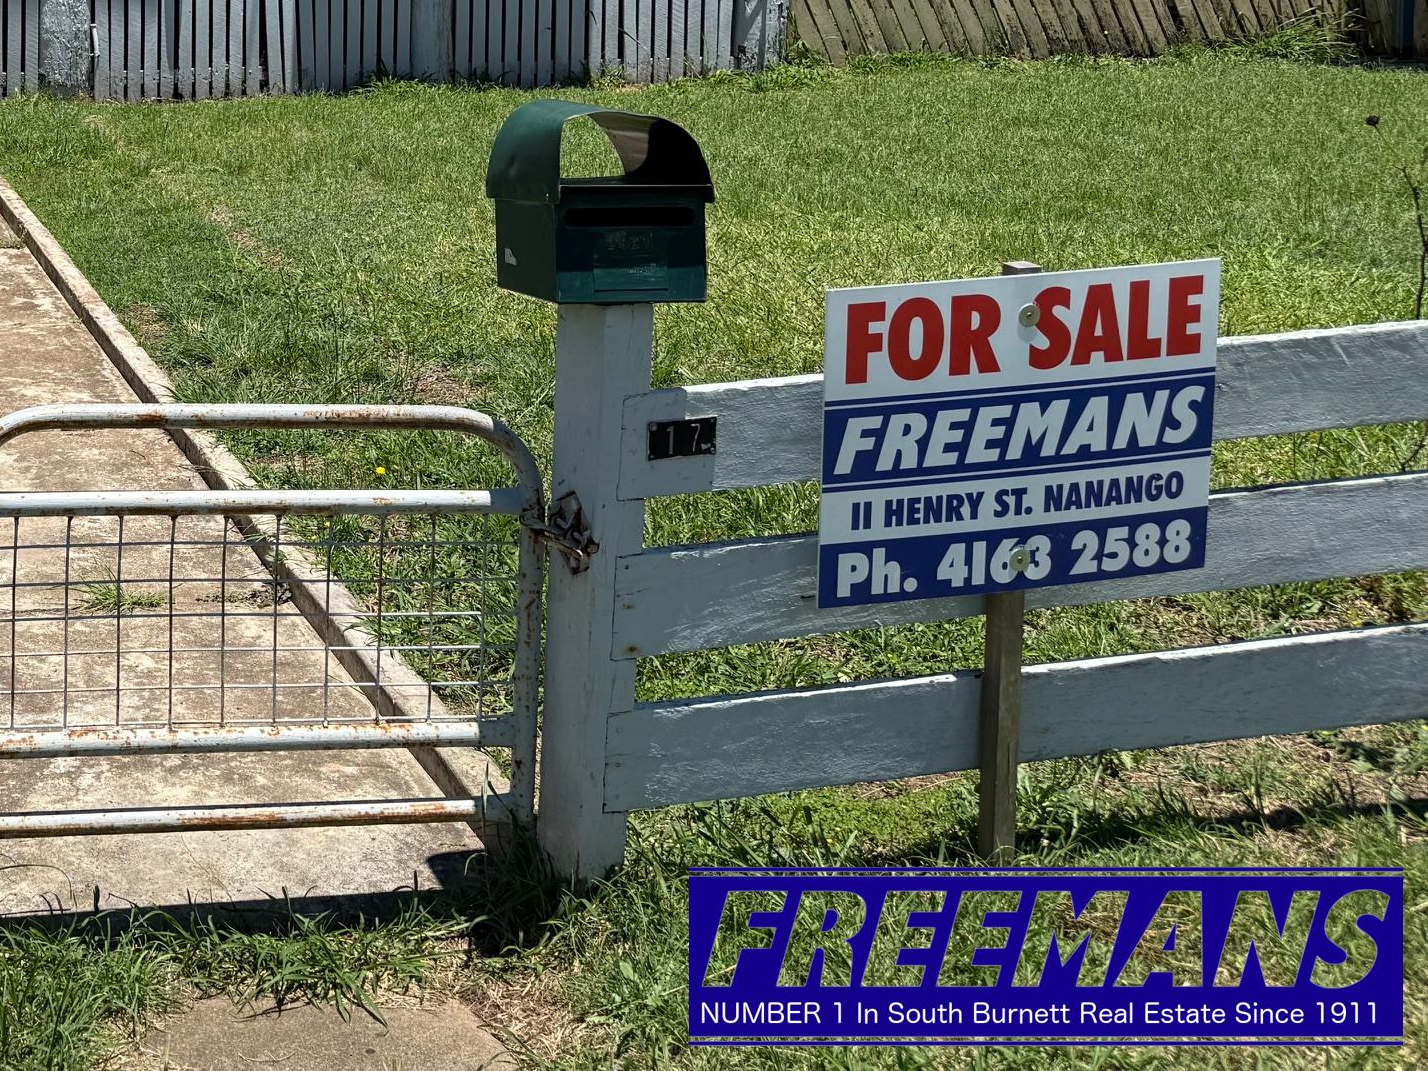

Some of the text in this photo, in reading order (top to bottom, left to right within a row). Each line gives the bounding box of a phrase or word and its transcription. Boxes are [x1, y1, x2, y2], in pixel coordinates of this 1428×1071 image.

[845, 274, 1204, 385] FOR SALE
[666, 423, 701, 455] 17
[833, 385, 1206, 475] FREEMANS
[884, 490, 984, 528] HENRY
[993, 487, 1032, 518] ST.
[1044, 471, 1184, 512] NANANGO
[836, 518, 1191, 598] Ph. 4163 2588
